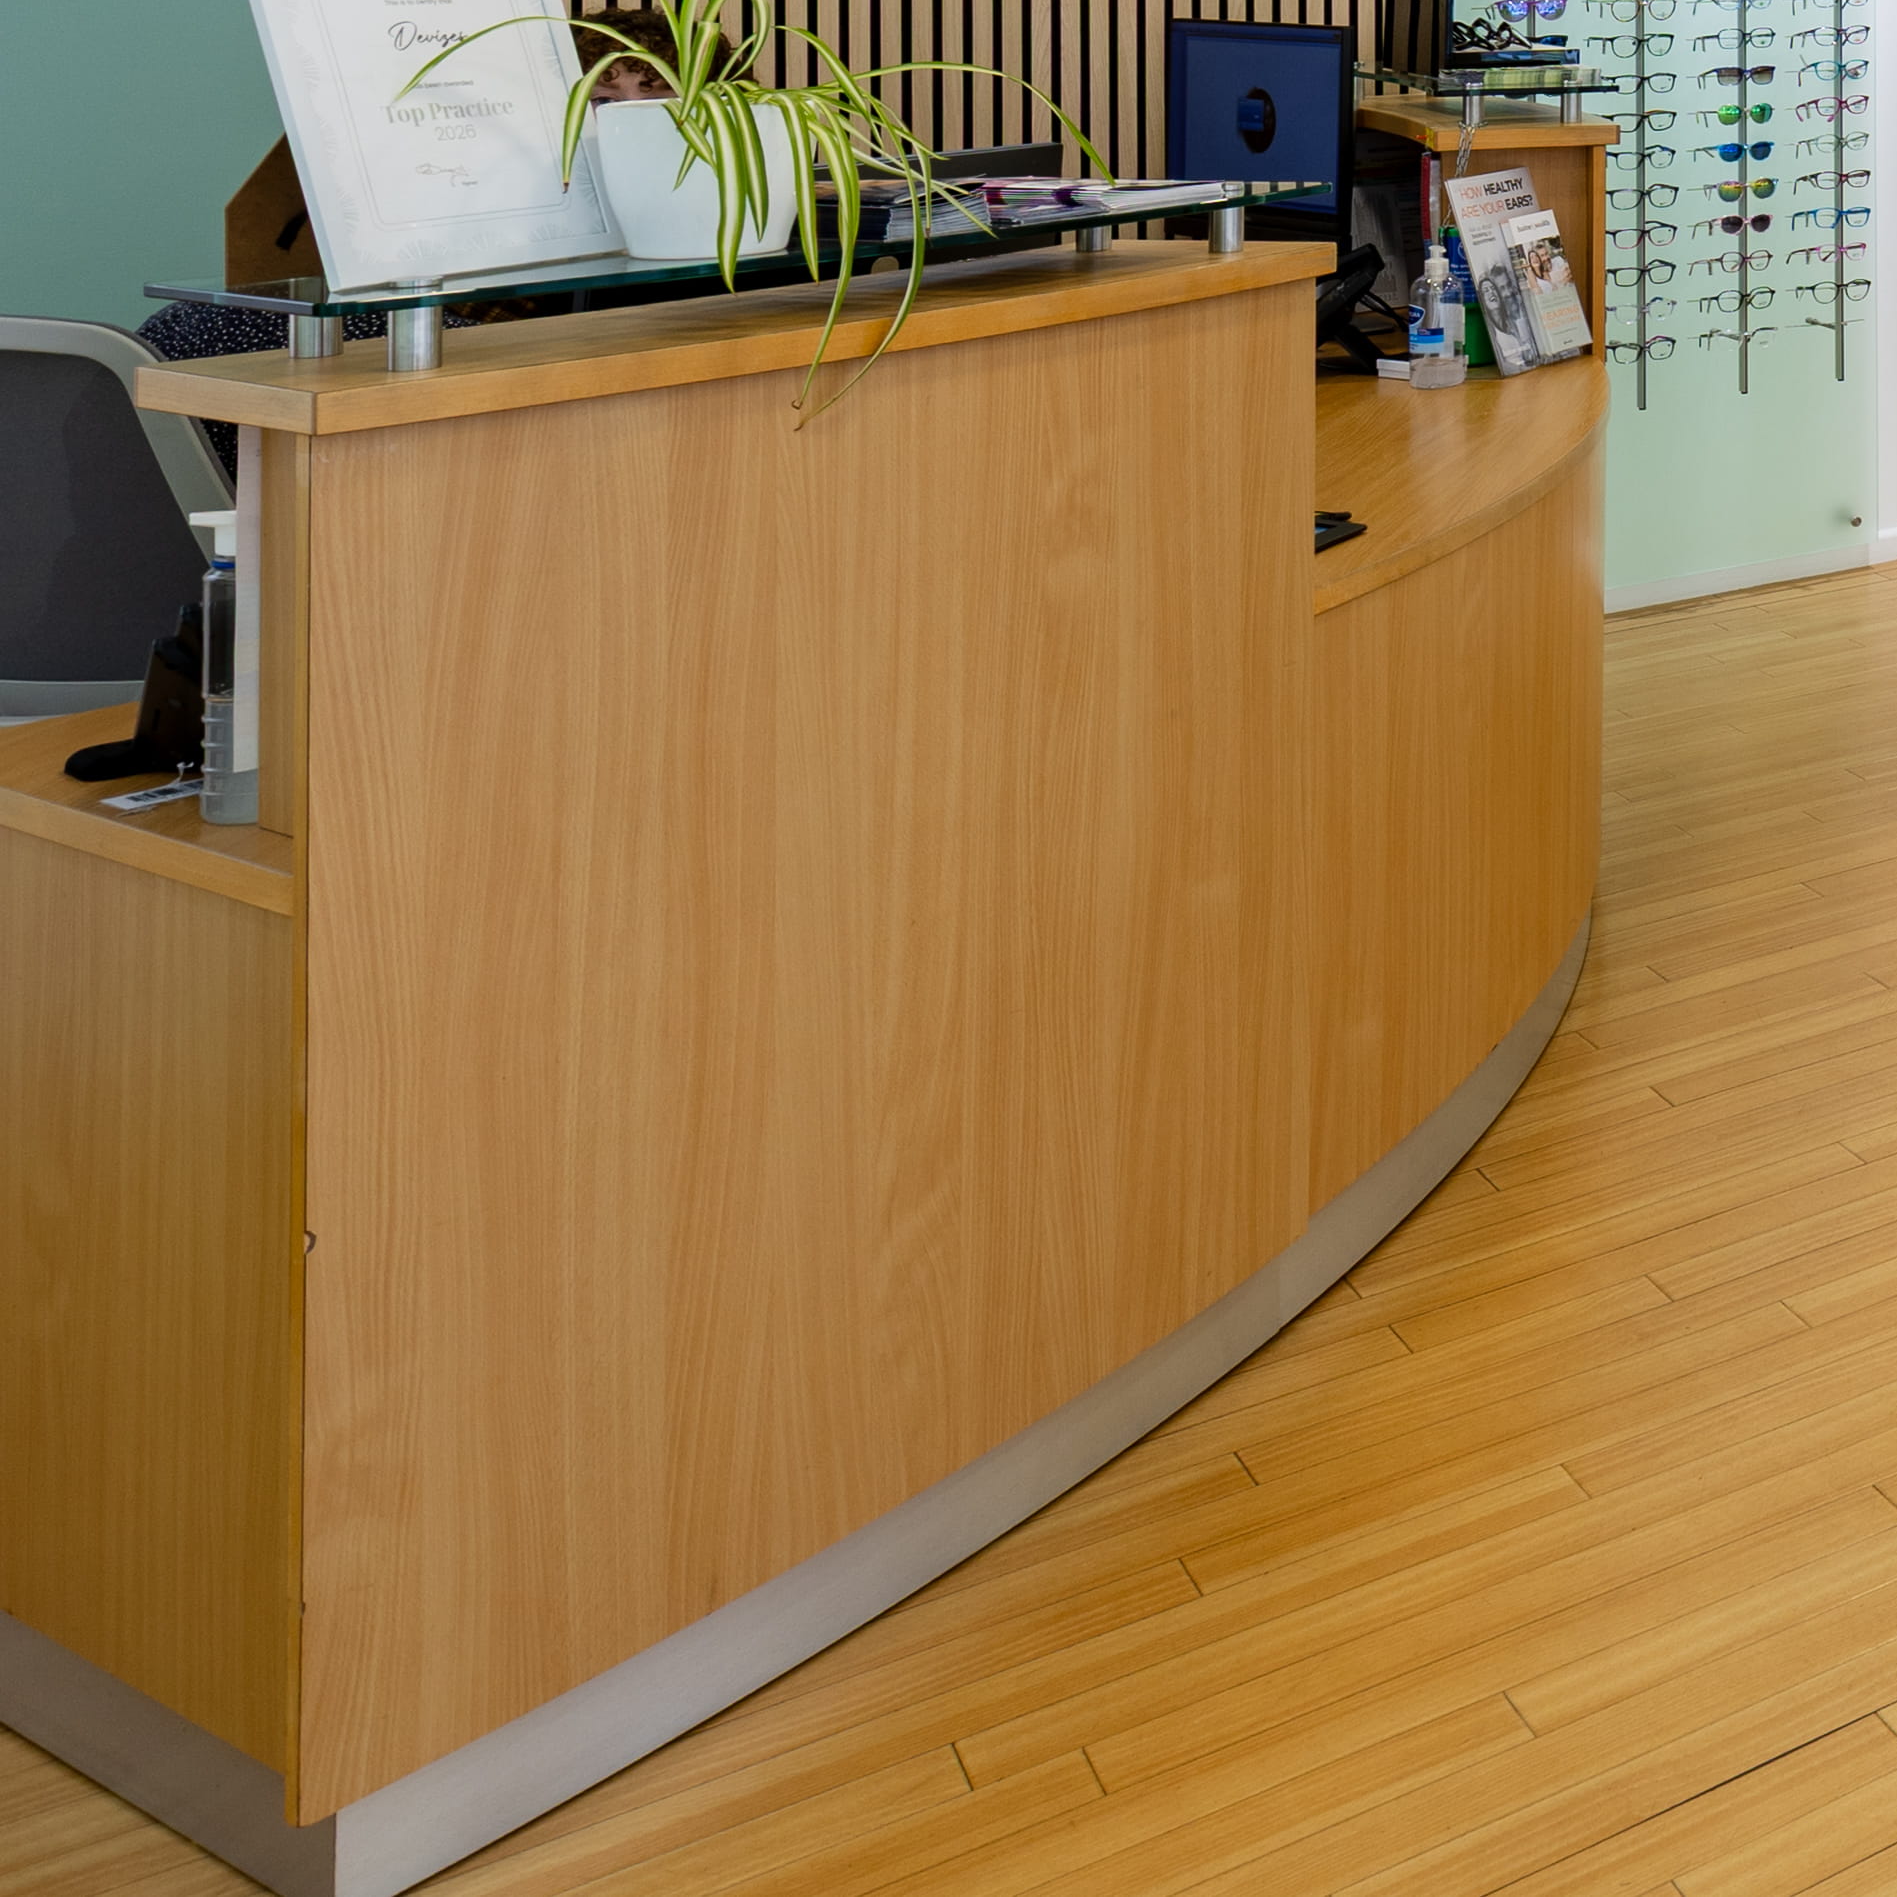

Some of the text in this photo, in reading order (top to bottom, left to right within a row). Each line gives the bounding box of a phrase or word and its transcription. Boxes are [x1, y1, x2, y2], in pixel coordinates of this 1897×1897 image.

[388, 20, 468, 51] Devizes
[383, 97, 514, 127] Top Practice
[1460, 177, 1524, 200] HOW HEALTHY
[1460, 194, 1534, 219] ARE YOUR EARS?
